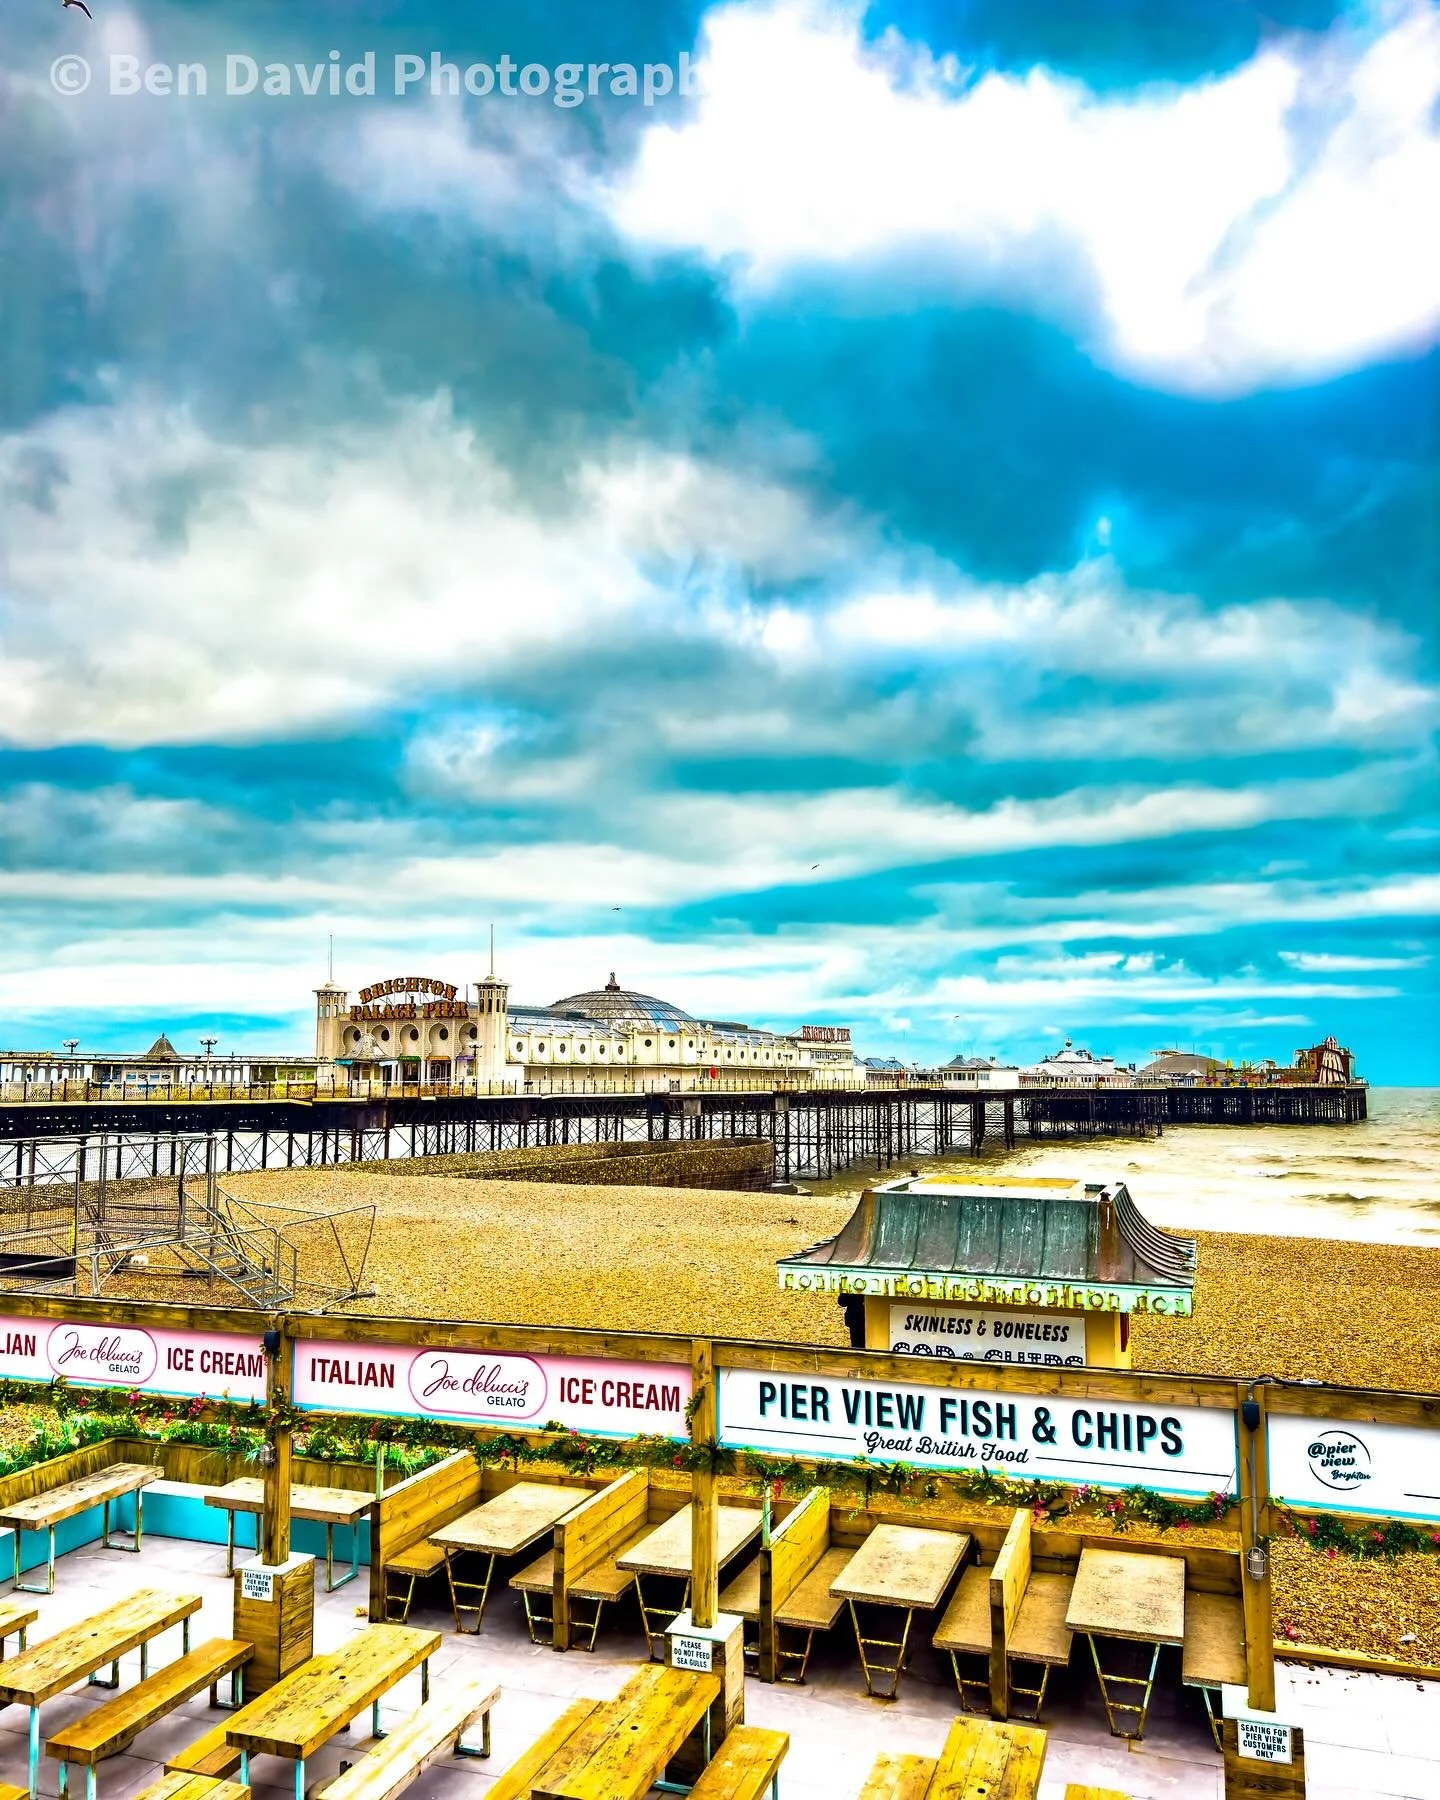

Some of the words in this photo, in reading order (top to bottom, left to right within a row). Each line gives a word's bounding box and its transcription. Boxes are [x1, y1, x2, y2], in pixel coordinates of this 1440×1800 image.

[359, 977, 459, 1004] BRIGHTON
[350, 1003, 416, 1020] PALACE
[423, 1001, 469, 1019] PIER
[802, 1025, 835, 1042] BRIGHTON
[904, 1314, 973, 1335] SKINLESS
[976, 1320, 986, 1336] &
[993, 1321, 1070, 1343] BONELESS
[0, 1333, 36, 1357] IAN
[58, 1331, 88, 1365] Joe
[109, 1363, 140, 1375] GELATO
[167, 1347, 194, 1372] ICE
[200, 1350, 263, 1378] CREAM
[311, 1358, 395, 1389] ITALIAN
[423, 1360, 460, 1397] Joe
[487, 1395, 526, 1408] GELATO
[560, 1377, 593, 1405] ICE
[602, 1380, 681, 1412] CREAM
[759, 1381, 830, 1422] PIER
[842, 1388, 925, 1432] VIEW
[939, 1397, 1017, 1441] FISH
[1031, 1406, 1057, 1445] &
[1071, 1409, 1184, 1457] CHIPS
[863, 1431, 913, 1454] Great
[915, 1436, 977, 1459] British
[981, 1443, 1029, 1464] Food
[1307, 1441, 1356, 1458] @pier
[1331, 1469, 1371, 1481] Brighton
[244, 1572, 261, 1580] SEATING
[245, 1584, 270, 1592] CUSTOMERS
[674, 1647, 682, 1656] DO
[683, 1649, 694, 1657] NOT
[696, 1651, 710, 1660] FEED
[680, 1640, 702, 1650] PLEASE
[677, 1657, 688, 1665] SEA
[689, 1659, 707, 1669] GULLS
[1240, 1724, 1271, 1735] SEATING
[1273, 1728, 1287, 1738] FOR
[1245, 1732, 1262, 1742] PIER
[1264, 1735, 1282, 1745] VIEW
[1243, 1739, 1286, 1753] CUSTOMERS
[1255, 1749, 1274, 1759] ONLY
